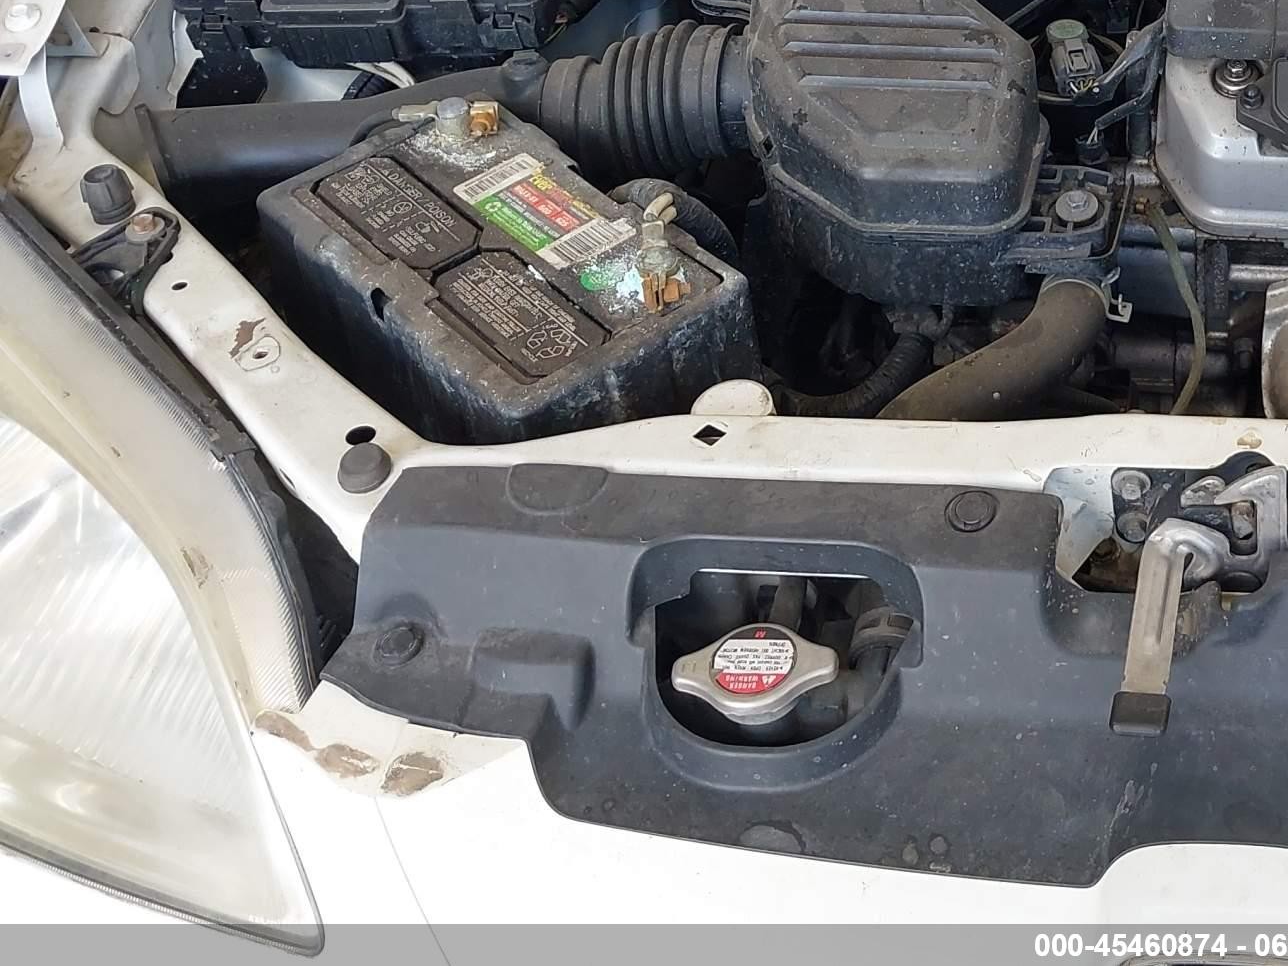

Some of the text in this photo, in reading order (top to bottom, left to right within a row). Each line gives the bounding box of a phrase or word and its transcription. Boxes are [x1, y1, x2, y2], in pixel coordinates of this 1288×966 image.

[386, 172, 424, 200] DANGER
[422, 200, 457, 227] POISON
[725, 674, 759, 682] WARNING
